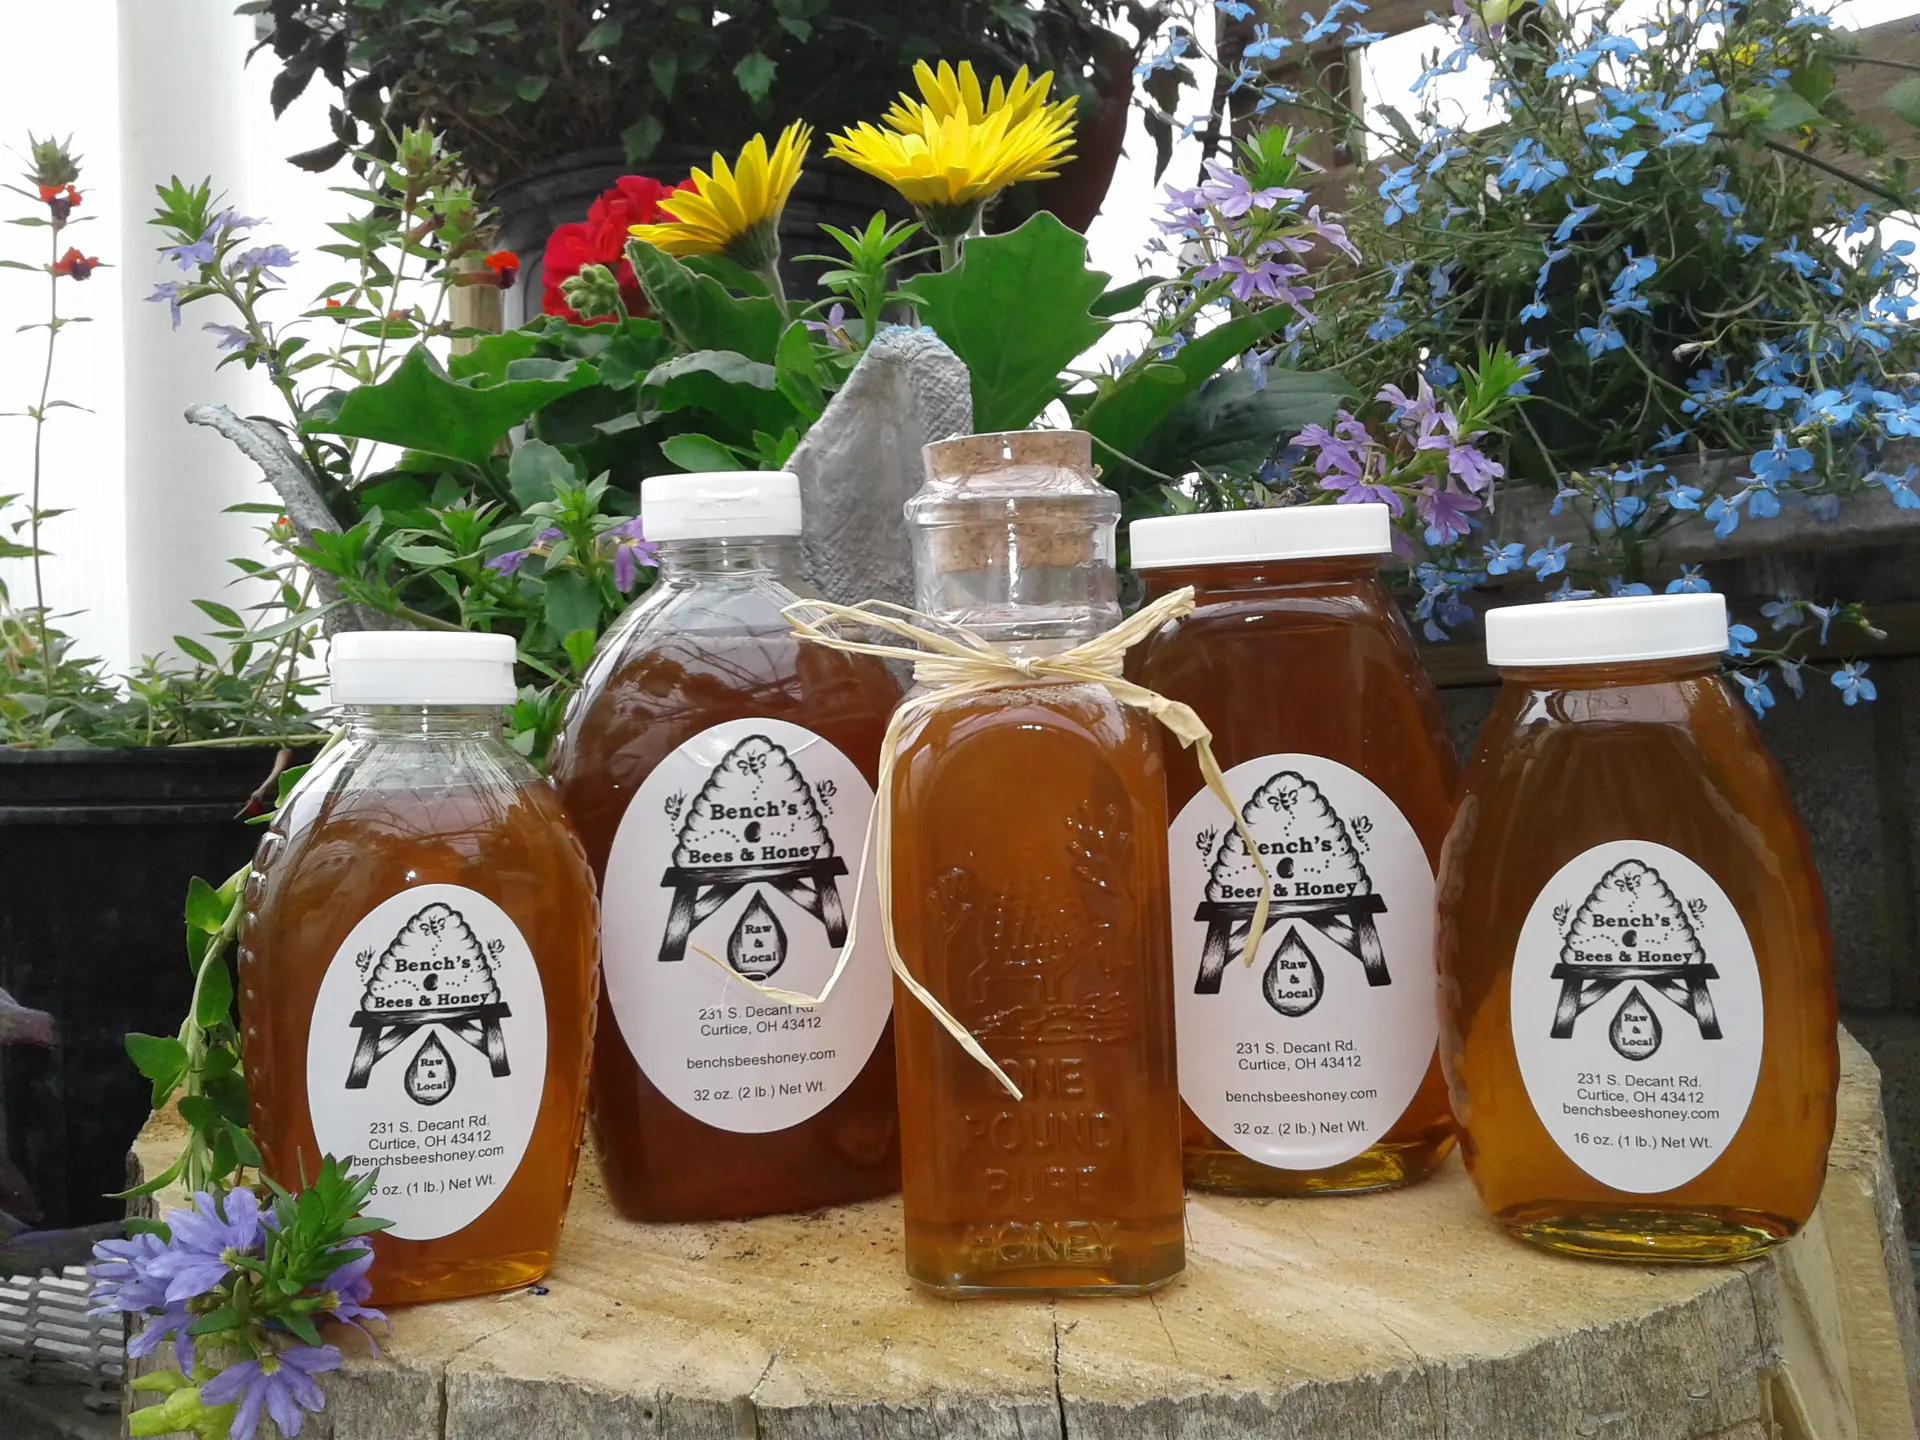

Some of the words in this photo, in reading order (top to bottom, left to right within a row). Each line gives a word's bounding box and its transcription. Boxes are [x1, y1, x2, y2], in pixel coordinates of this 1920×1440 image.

[710, 800, 798, 820] Bench's
[689, 849, 733, 865] Bees
[740, 847, 755, 862] &
[762, 843, 821, 860] Honey
[1273, 883, 1288, 897] &
[1295, 881, 1358, 897] Honey
[1592, 913, 1671, 927] Bench's
[745, 924, 772, 935] Raw
[754, 938, 764, 948] &
[395, 955, 471, 973] Bench's
[742, 952, 777, 963] Local
[1280, 960, 1308, 970] Raw
[1574, 951, 1612, 963] Bees
[1619, 950, 1632, 963] &
[1637, 951, 1693, 964] Honey
[1289, 975, 1300, 985] &
[374, 996, 413, 1010] Bees
[419, 995, 432, 1007] &
[438, 992, 490, 1007] Honey
[1278, 988, 1314, 1000] Local
[699, 1008, 723, 1020] 231
[728, 1007, 741, 1019] S.
[746, 1004, 792, 1018] Decant
[1624, 1013, 1648, 1022] Raw
[700, 1024, 752, 1036] Curtice,
[756, 1021, 777, 1033] OH
[782, 1017, 821, 1030] 43412
[1632, 1025, 1641, 1034] &
[1236, 1042, 1260, 1054] 231
[1265, 1041, 1279, 1054] S.
[1283, 1040, 1331, 1054] Decant
[1335, 1039, 1357, 1052] Rd.
[1621, 1037, 1653, 1046] Local
[420, 1058, 444, 1067] Raw
[687, 1048, 836, 1070] benchsbeeshoney.com
[1238, 1058, 1291, 1071] Curtice,
[1294, 1057, 1316, 1070] OH
[1320, 1055, 1362, 1069] 43412
[427, 1070, 437, 1079] &
[1577, 1073, 1601, 1085] 231
[1606, 1074, 1621, 1086] S.
[1625, 1075, 1675, 1088] Decant
[1678, 1075, 1702, 1088] Rd.
[417, 1081, 447, 1091] Local
[693, 1088, 711, 1101] 32
[714, 1088, 733, 1101] oz.
[738, 1085, 752, 1102] (2
[755, 1084, 776, 1100] lb.)
[779, 1081, 803, 1096] Net
[806, 1080, 827, 1093] Wt.
[1226, 1087, 1378, 1103] benchsbeeshoney.com
[1577, 1088, 1629, 1103] Curtice,
[1632, 1091, 1656, 1103] OH
[1660, 1091, 1705, 1104] 43412
[1563, 1103, 1720, 1121] benchsbeeshoney.com
[369, 1122, 393, 1134] 231
[399, 1121, 413, 1133] S.
[418, 1118, 464, 1132] Decant
[469, 1115, 490, 1127] Rd.
[1234, 1123, 1251, 1135] 32
[1254, 1125, 1274, 1135] oz.
[1278, 1122, 1292, 1137] (2
[1294, 1122, 1317, 1137] lb.)
[1320, 1121, 1343, 1134] Net
[1346, 1120, 1369, 1133] Wt.
[368, 1138, 420, 1150] Curtice,
[424, 1135, 446, 1147] OH
[450, 1130, 492, 1145] 43412
[1573, 1132, 1589, 1145] 16
[1593, 1136, 1614, 1146] oz.
[1618, 1134, 1631, 1149] (1
[1635, 1135, 1658, 1150] lb.)
[1661, 1137, 1686, 1149] Net
[1689, 1137, 1713, 1149] Wt.
[353, 1145, 504, 1167] benchsbeeshoney.com
[382, 1185, 402, 1195] oz.
[406, 1182, 418, 1196] (1
[424, 1180, 445, 1194] lb.)
[449, 1177, 472, 1191] Net
[475, 1174, 496, 1187] Wt.
